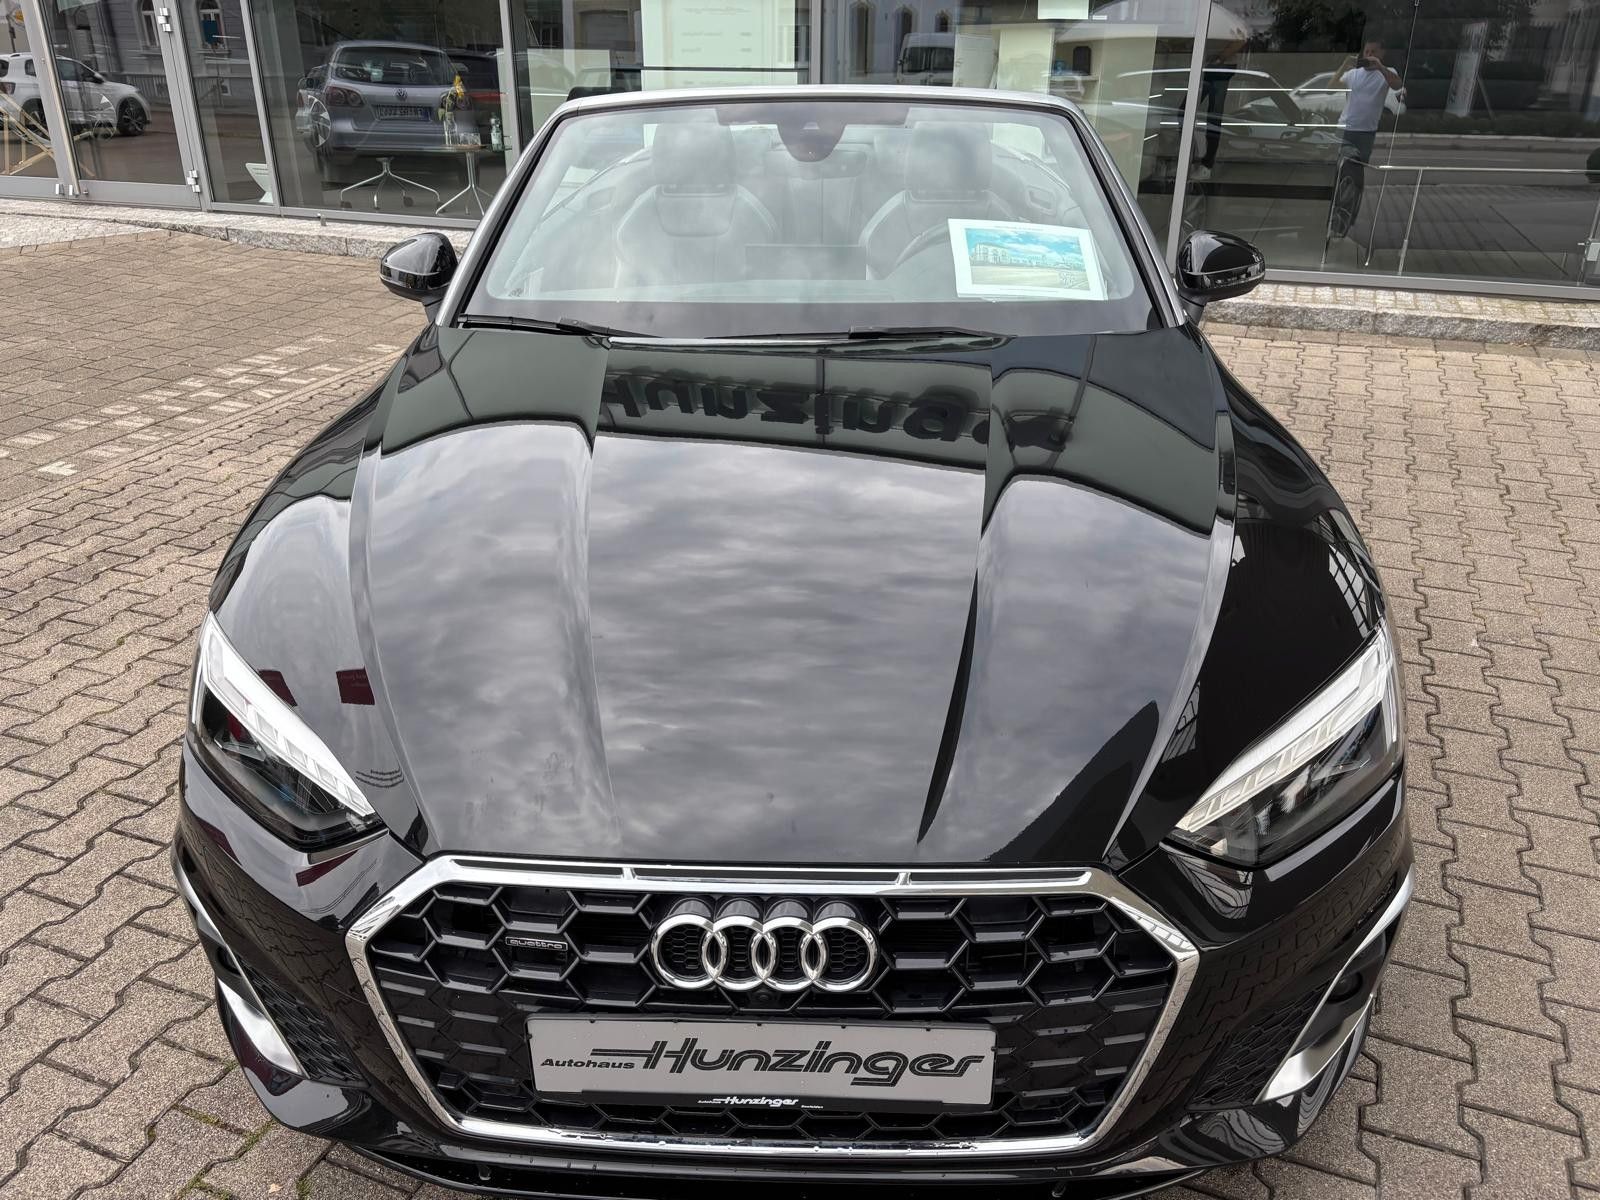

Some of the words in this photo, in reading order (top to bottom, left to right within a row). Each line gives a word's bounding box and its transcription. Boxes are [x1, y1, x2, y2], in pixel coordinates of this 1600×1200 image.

[509, 939, 563, 950] quattro
[540, 1058, 635, 1070] Autohaus
[590, 1037, 985, 1087] Hunzinger
[713, 1096, 799, 1107] Hunzinger
